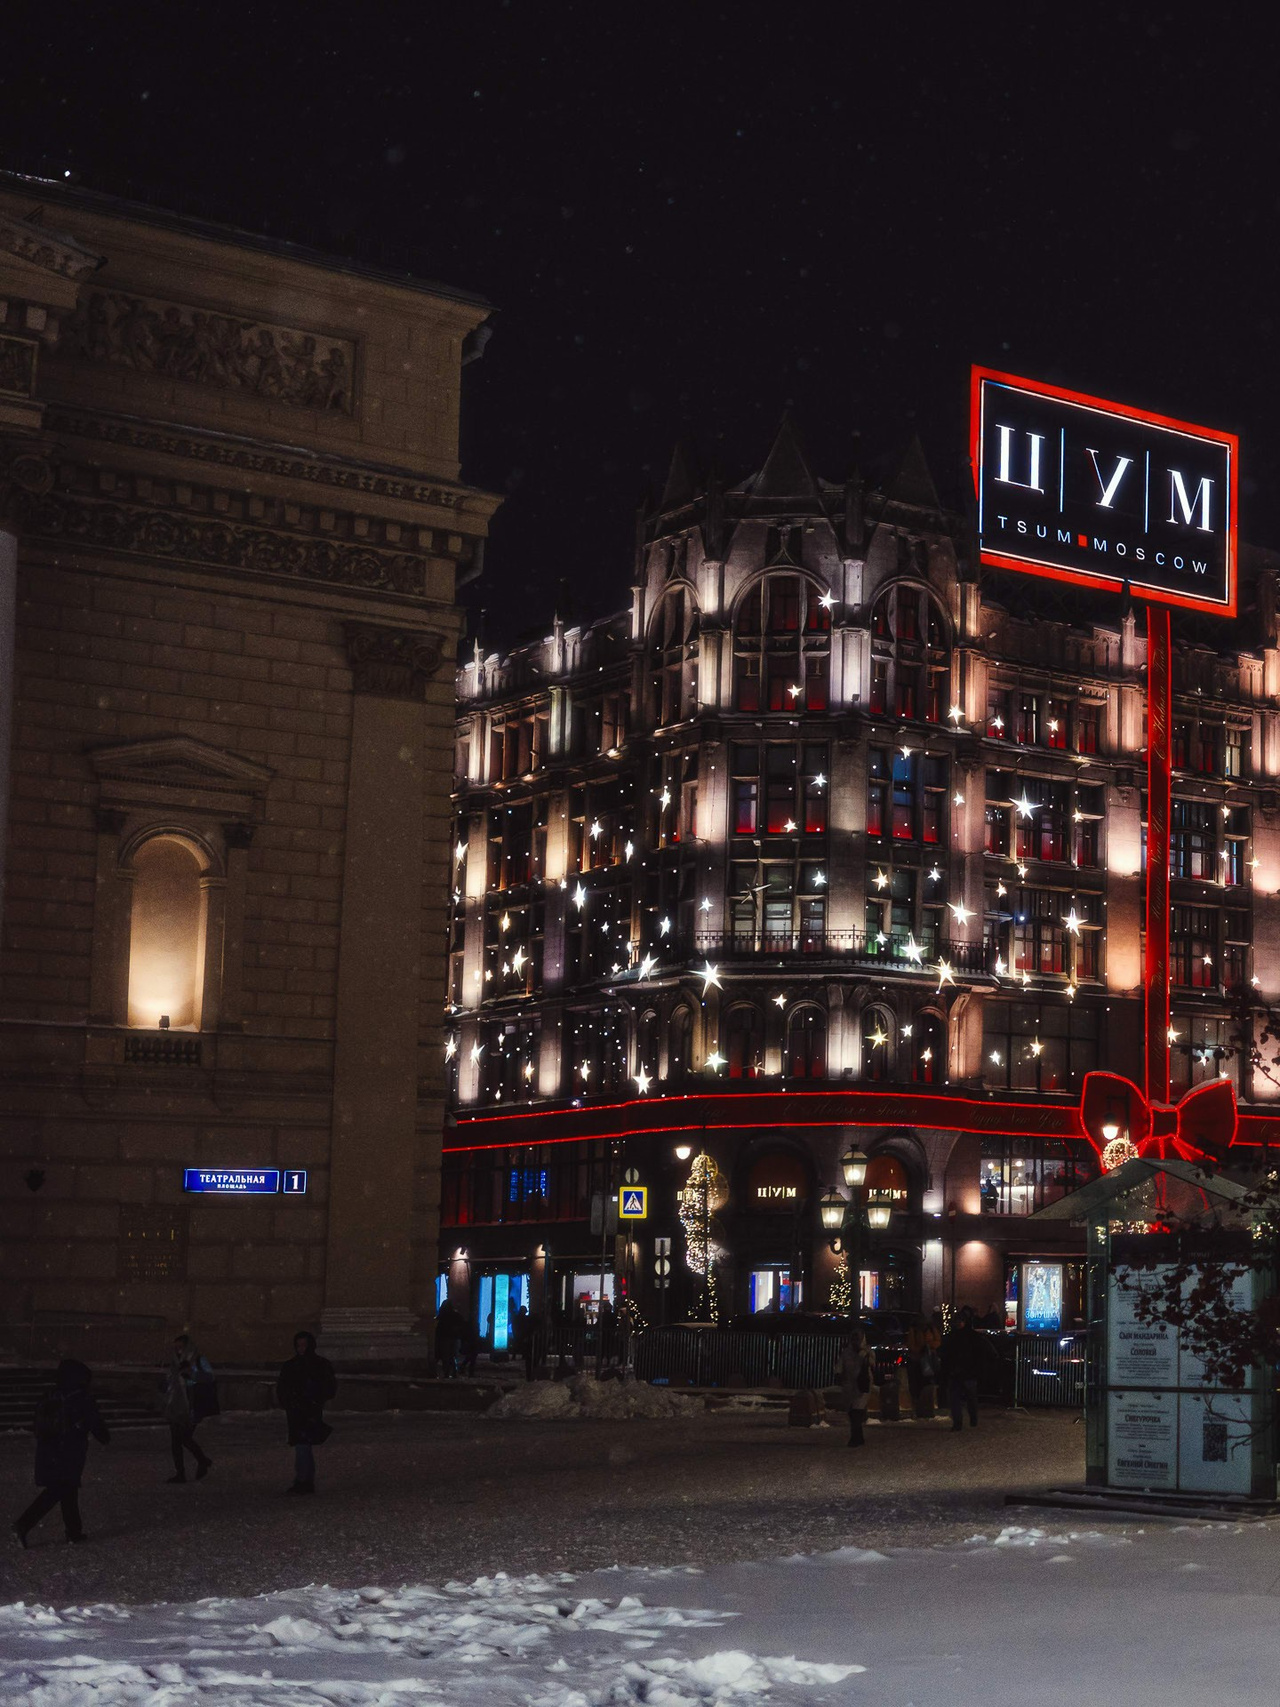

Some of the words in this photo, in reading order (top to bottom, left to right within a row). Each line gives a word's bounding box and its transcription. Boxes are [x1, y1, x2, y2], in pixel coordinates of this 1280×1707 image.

[997, 515, 1071, 543] TSUM
[1094, 538, 1206, 574] MOSCOW
[200, 1174, 266, 1185] ТЕАТРАЛЬНАЯ
[291, 1174, 299, 1190] 1
